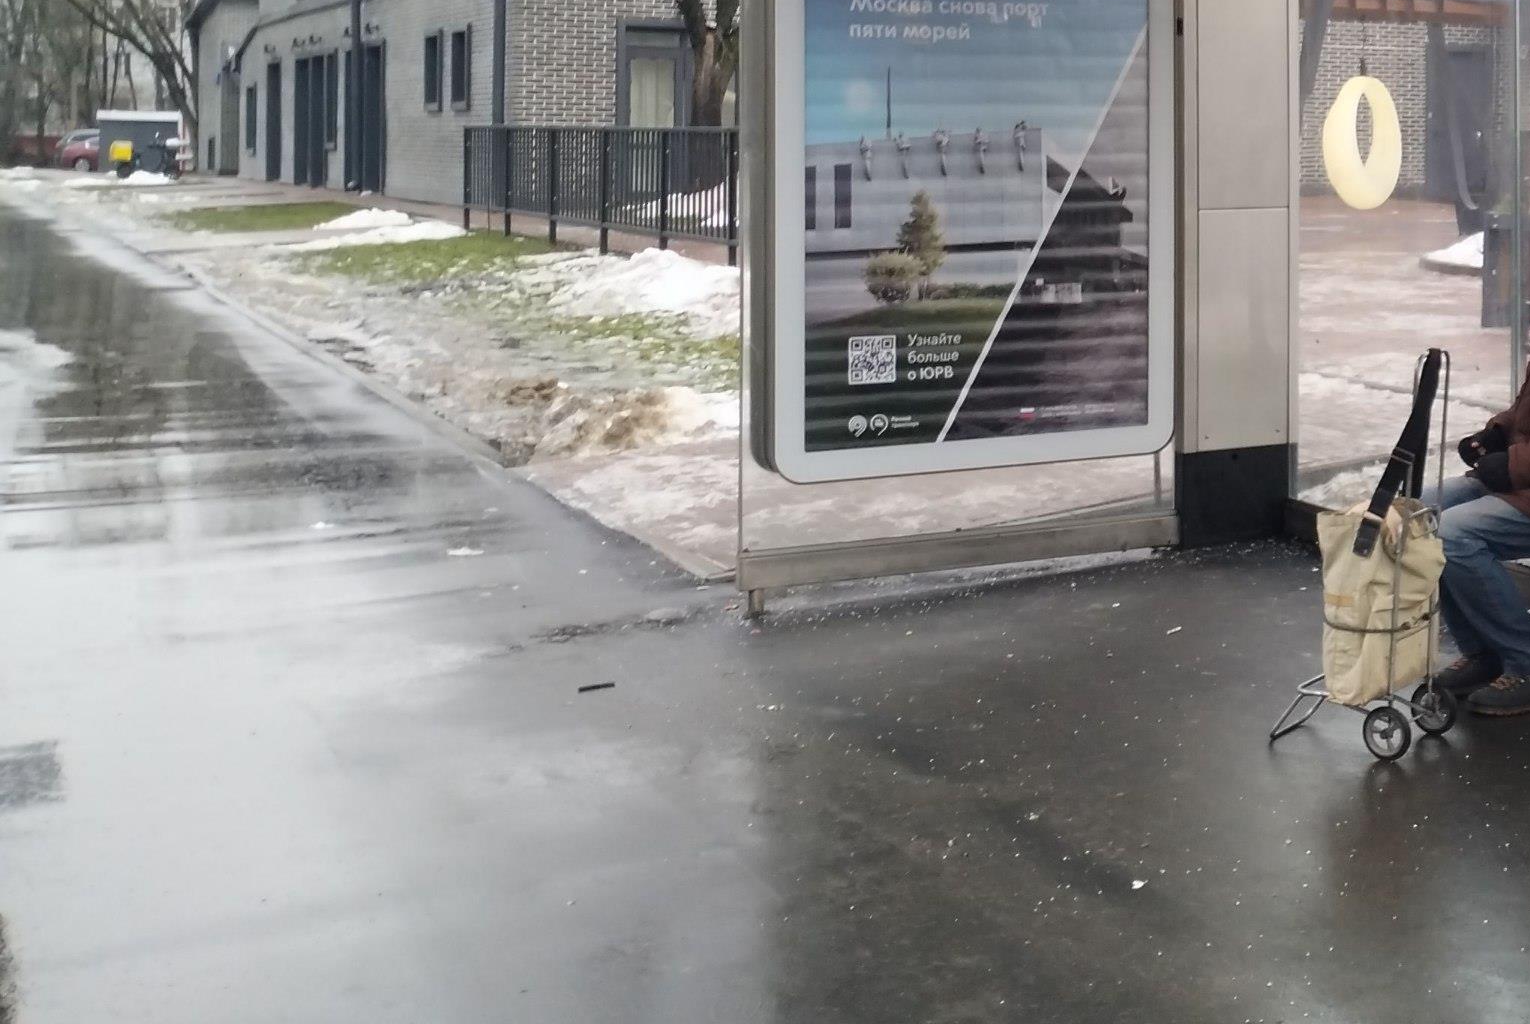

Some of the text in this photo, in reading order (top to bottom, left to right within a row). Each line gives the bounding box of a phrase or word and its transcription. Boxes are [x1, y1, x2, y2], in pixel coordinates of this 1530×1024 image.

[1001, 1, 1050, 20] порт
[849, 20, 971, 43] пяти морей
[907, 332, 962, 347] Узнайте
[907, 349, 960, 364] больше
[919, 365, 954, 380] ЮРВ
